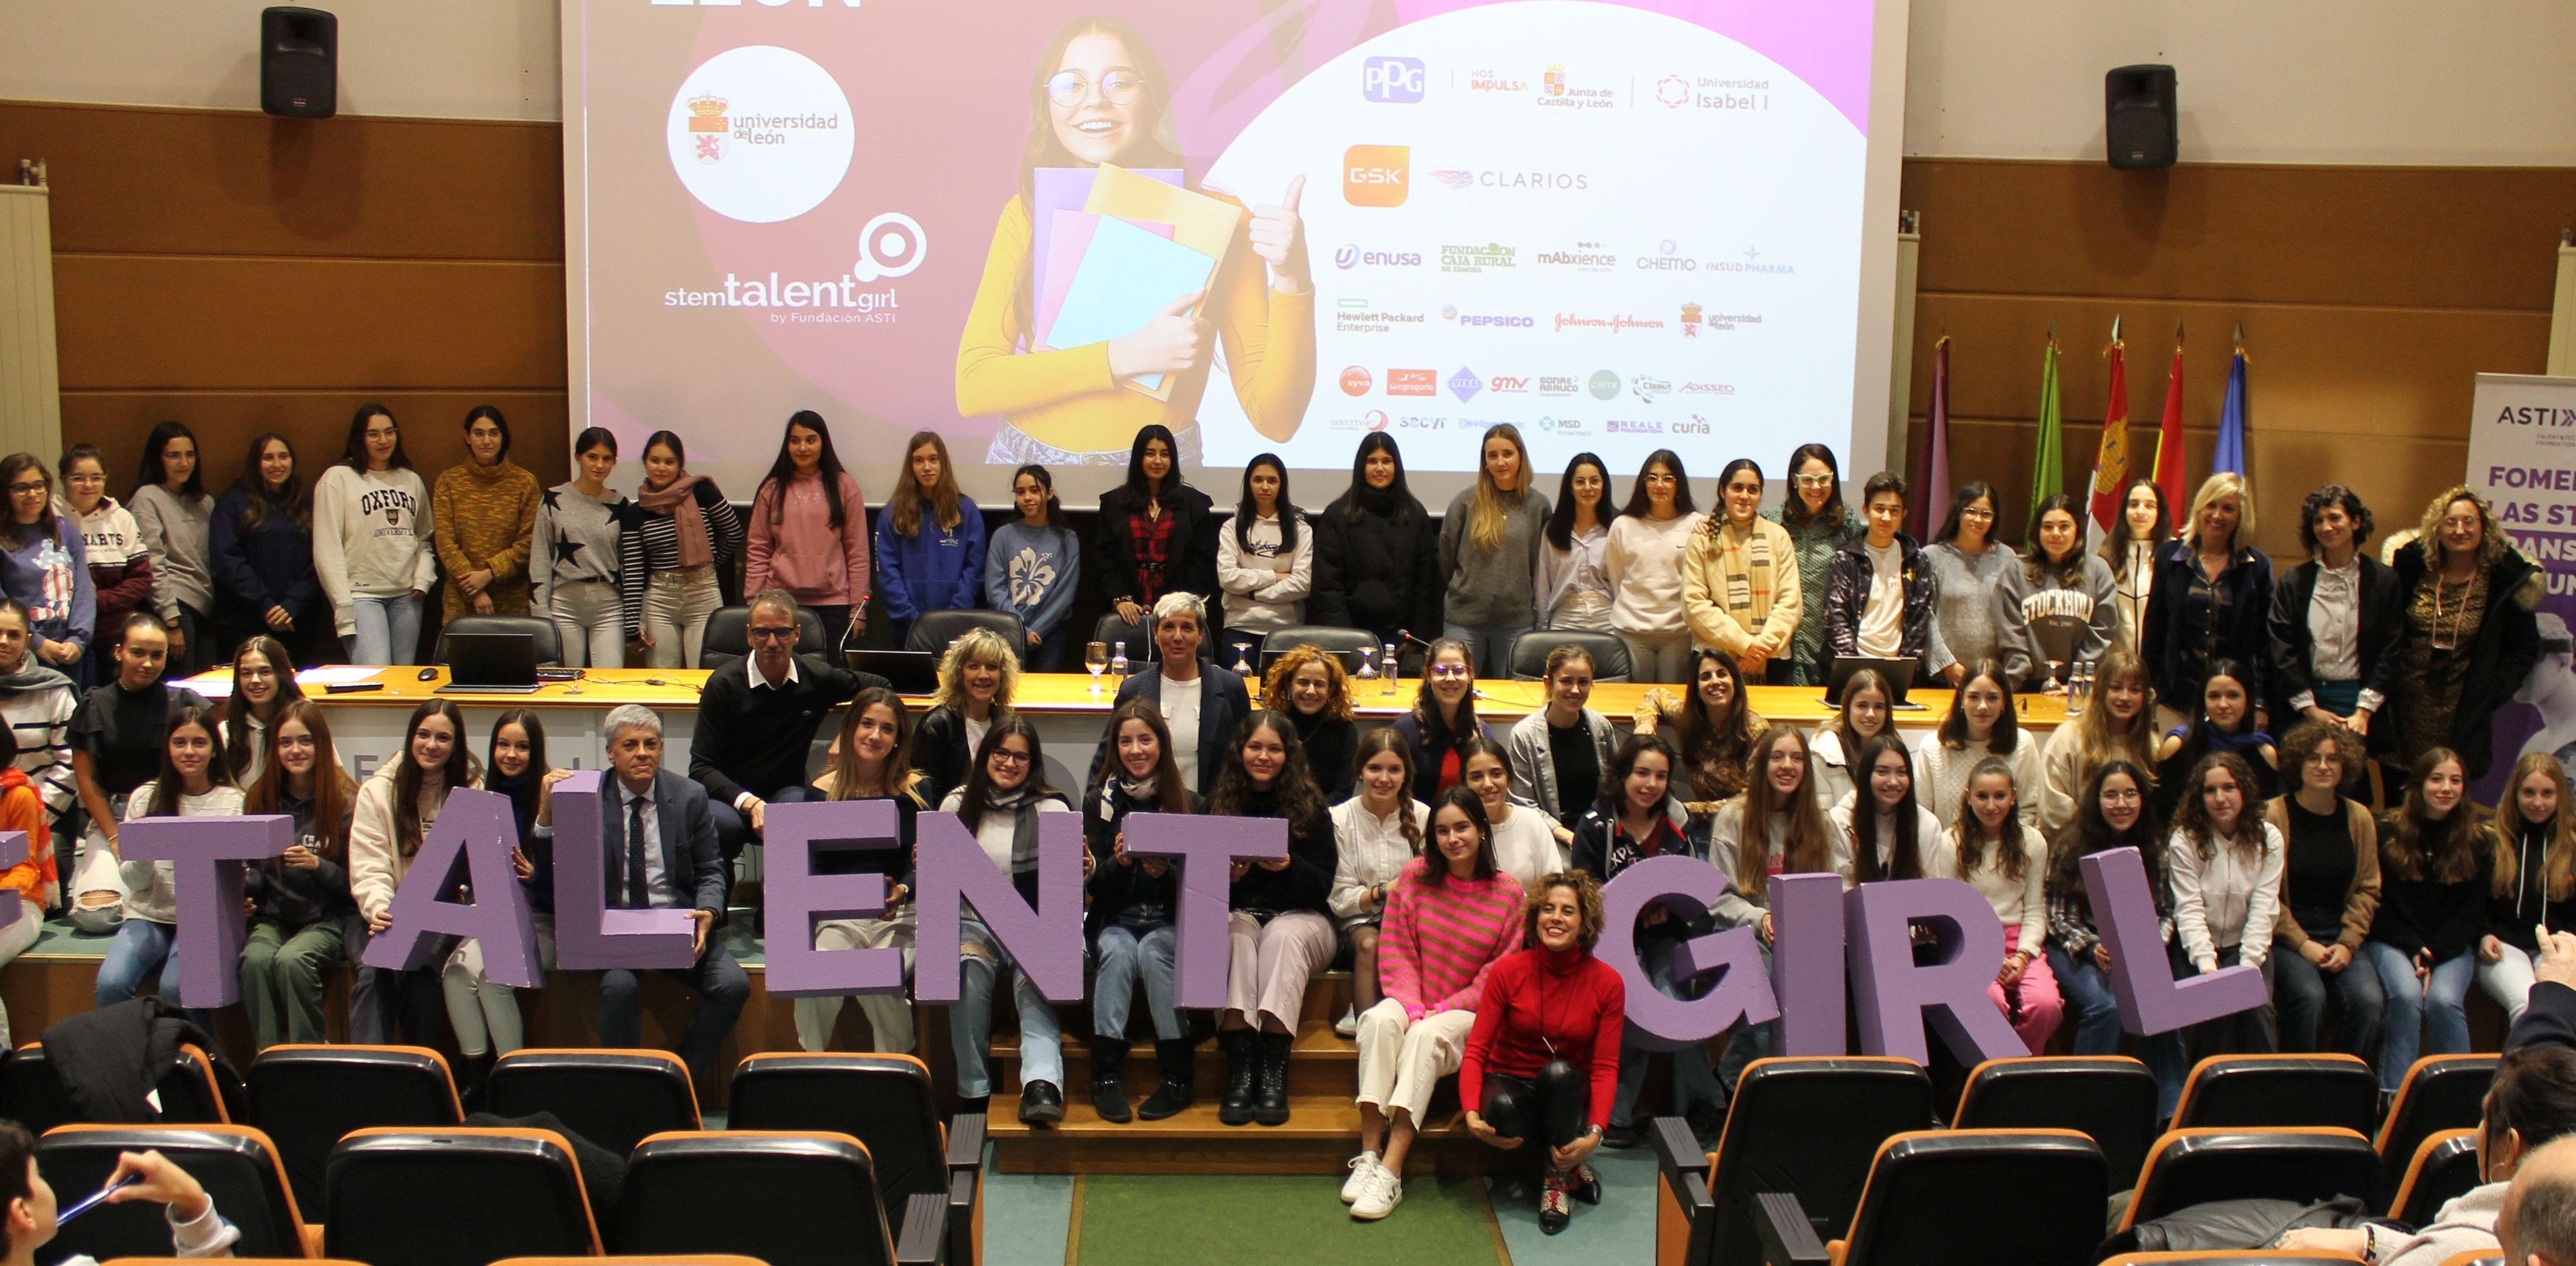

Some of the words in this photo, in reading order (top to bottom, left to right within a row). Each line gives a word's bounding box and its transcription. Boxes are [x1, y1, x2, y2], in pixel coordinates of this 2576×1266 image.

[1366, 61, 1422, 99] PPG
[1471, 70, 1494, 78] NOS
[1698, 78, 1769, 90] Universidad
[1566, 88, 1597, 98] Junta
[1600, 89, 1614, 98] de
[1537, 98, 1575, 108] Castilla
[1577, 101, 1584, 109] y
[1587, 98, 1614, 108] León
[1697, 93, 1756, 110] Isabel
[1763, 95, 1768, 110] I
[733, 113, 838, 130] universidad
[1350, 168, 1402, 185] GSK
[1480, 171, 1588, 190] CLARIOS
[1441, 244, 1516, 257] FUNDACON
[1363, 251, 1422, 266] enusa
[1441, 254, 1471, 266] CAJA
[1474, 256, 1516, 267] RURAL
[1537, 250, 1616, 266] mAbxience
[1637, 256, 1697, 271] CHEMO
[1706, 262, 1743, 273] INSUD
[1744, 263, 1795, 274] PHARMA
[770, 313, 787, 323] by
[791, 311, 861, 323] Fundación
[865, 313, 896, 323] ASTI
[1337, 311, 1379, 322] Hewlett
[1382, 313, 1424, 323] Packard
[1460, 315, 1534, 328] PEPSICO
[1708, 313, 1762, 323] universidad
[1337, 322, 1390, 333] Enterprise
[1453, 378, 1477, 388] VEKA
[1491, 376, 1532, 392] gmv
[2497, 406, 2557, 426] ASTI
[1558, 419, 1581, 429] MSD
[1621, 420, 1663, 429] REALE
[1672, 420, 1710, 434] curia
[362, 489, 417, 517] OXFORD
[119, 769, 1288, 1009] TALENT
[1592, 846, 2268, 1067] GIRL
